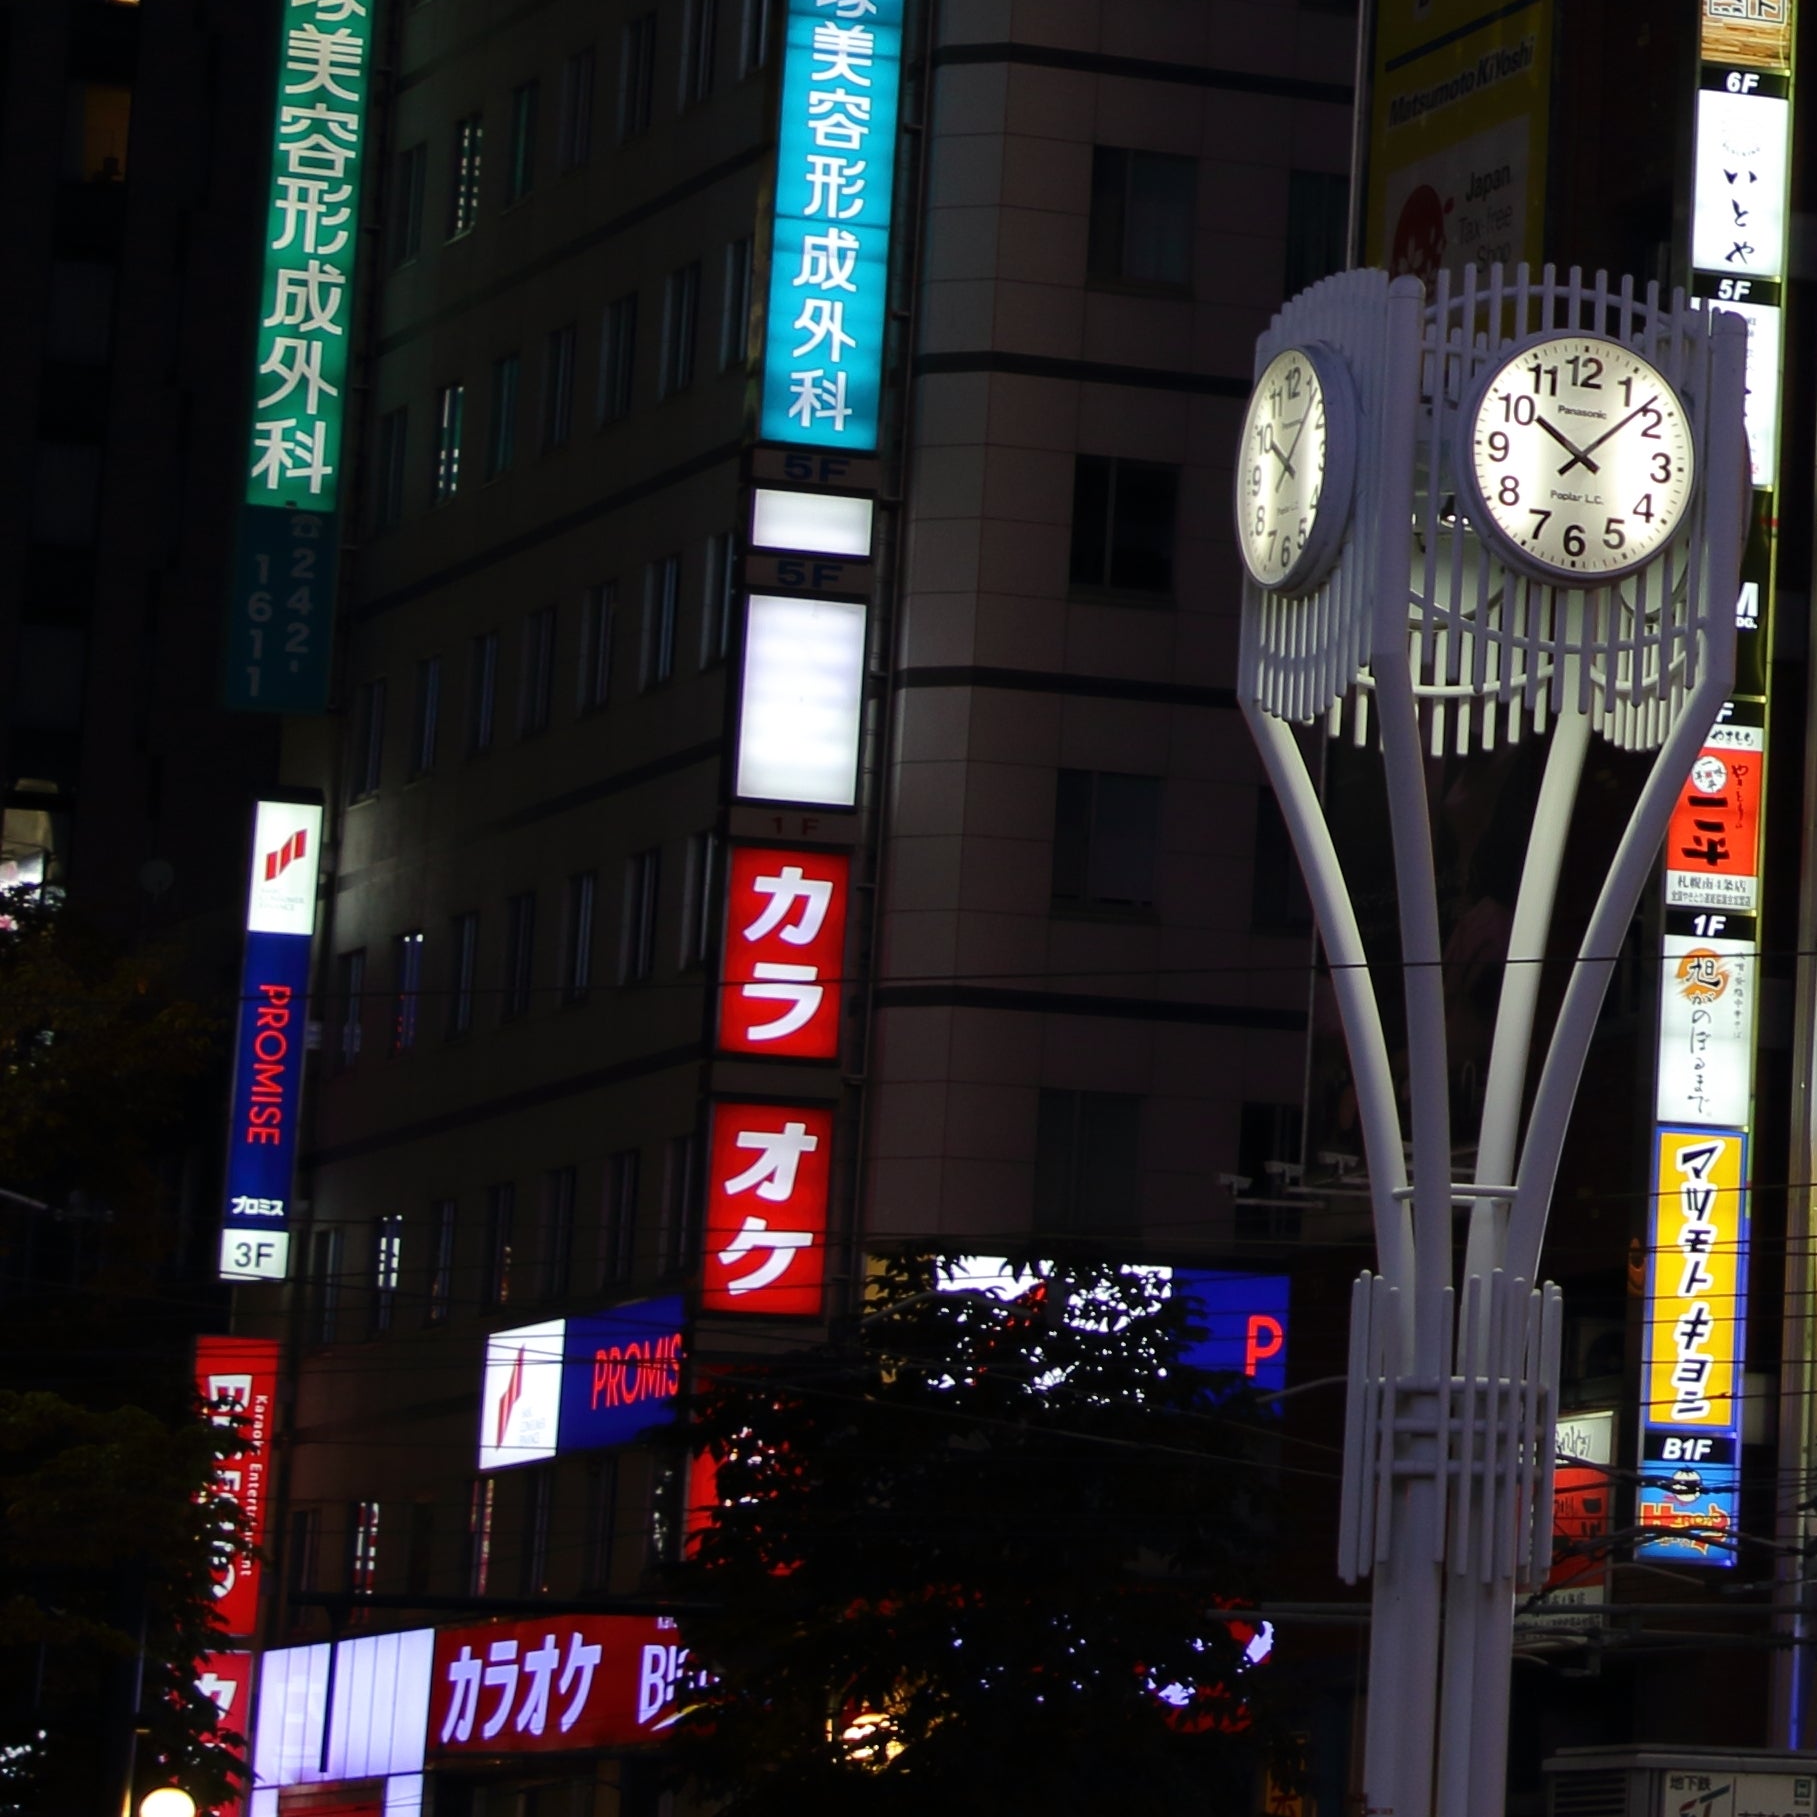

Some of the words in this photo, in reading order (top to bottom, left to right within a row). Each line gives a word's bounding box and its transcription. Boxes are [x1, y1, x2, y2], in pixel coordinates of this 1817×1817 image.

[1726, 72, 1760, 94] 6F
[1465, 161, 1511, 203] Japan
[1723, 168, 1758, 265] いとや
[1718, 279, 1751, 300] 5F
[1284, 366, 1301, 401] 12
[1527, 362, 1558, 397] 11
[1566, 355, 1603, 389] 12
[1618, 377, 1633, 408] 1
[1498, 393, 1537, 426] 10
[1558, 405, 1607, 420] Panasonic
[1641, 407, 1663, 439] 2
[1256, 423, 1273, 456] 10
[1487, 430, 1510, 462] 9
[783, 455, 851, 482] 5F
[1650, 452, 1672, 484] 3
[1498, 475, 1521, 506] 8
[1550, 489, 1581, 504] Poplar
[1528, 508, 1552, 540] 7
[1633, 493, 1655, 523] 4
[1562, 524, 1587, 557] 6
[1602, 518, 1626, 550] 5
[777, 559, 845, 587] 5F
[1694, 914, 1726, 936] 1F
[244, 983, 293, 1144] PROMISE
[231, 1194, 285, 1217] プロミス
[234, 1242, 276, 1269] 3F
[1677, 1145, 1721, 1414] マツモトキヨシ
[592, 1333, 683, 1411] PROMIS
[1662, 1437, 1713, 1462] B1F
[441, 1632, 602, 1744] カラオケ
